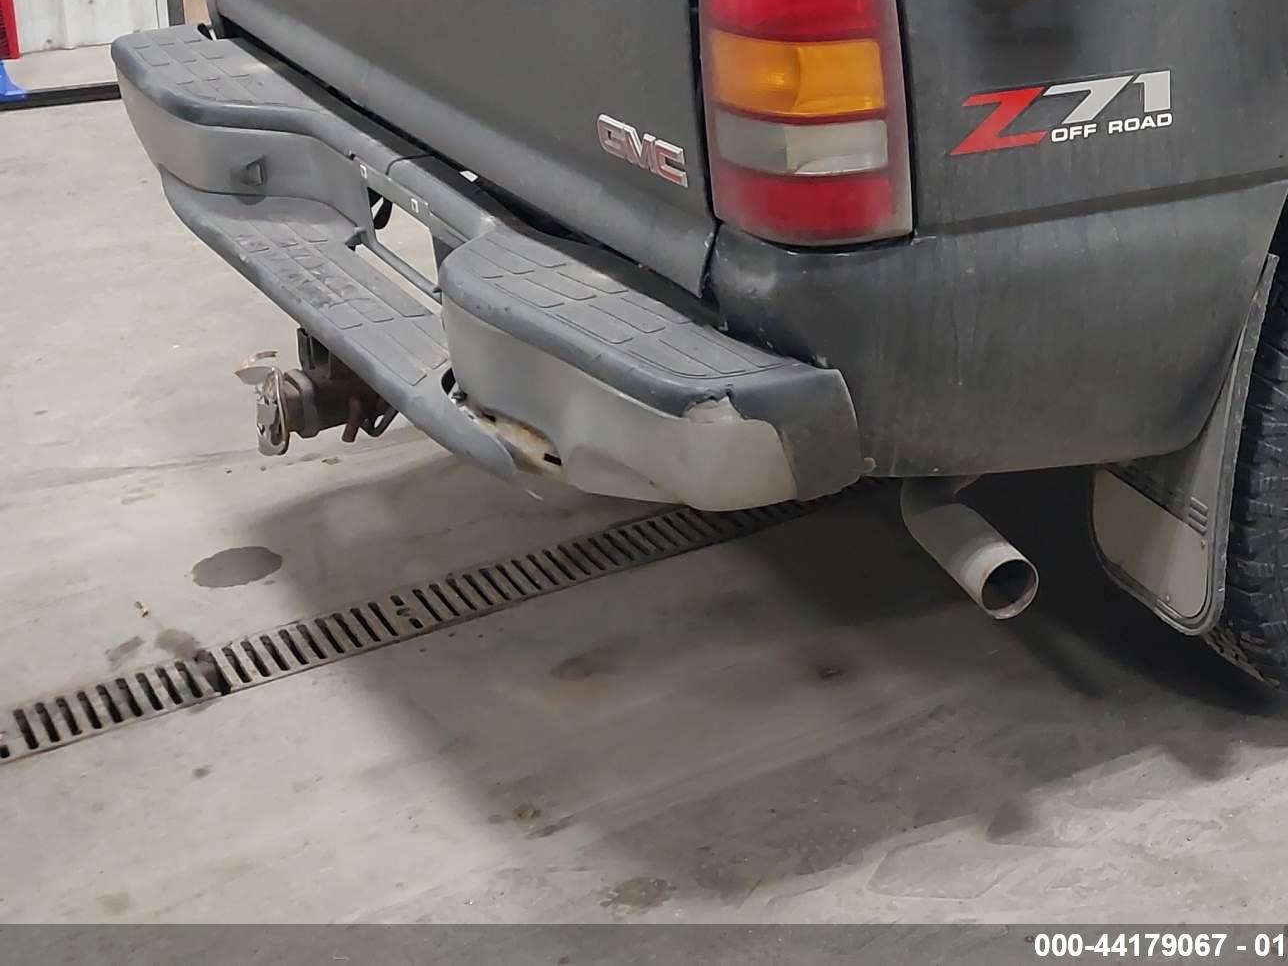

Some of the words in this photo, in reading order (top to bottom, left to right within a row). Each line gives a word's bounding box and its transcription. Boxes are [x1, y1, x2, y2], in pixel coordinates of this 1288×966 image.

[949, 70, 1171, 156] Z71
[1050, 123, 1098, 143] OFF
[1107, 113, 1173, 135] ROAD
[597, 114, 689, 188] GMC
